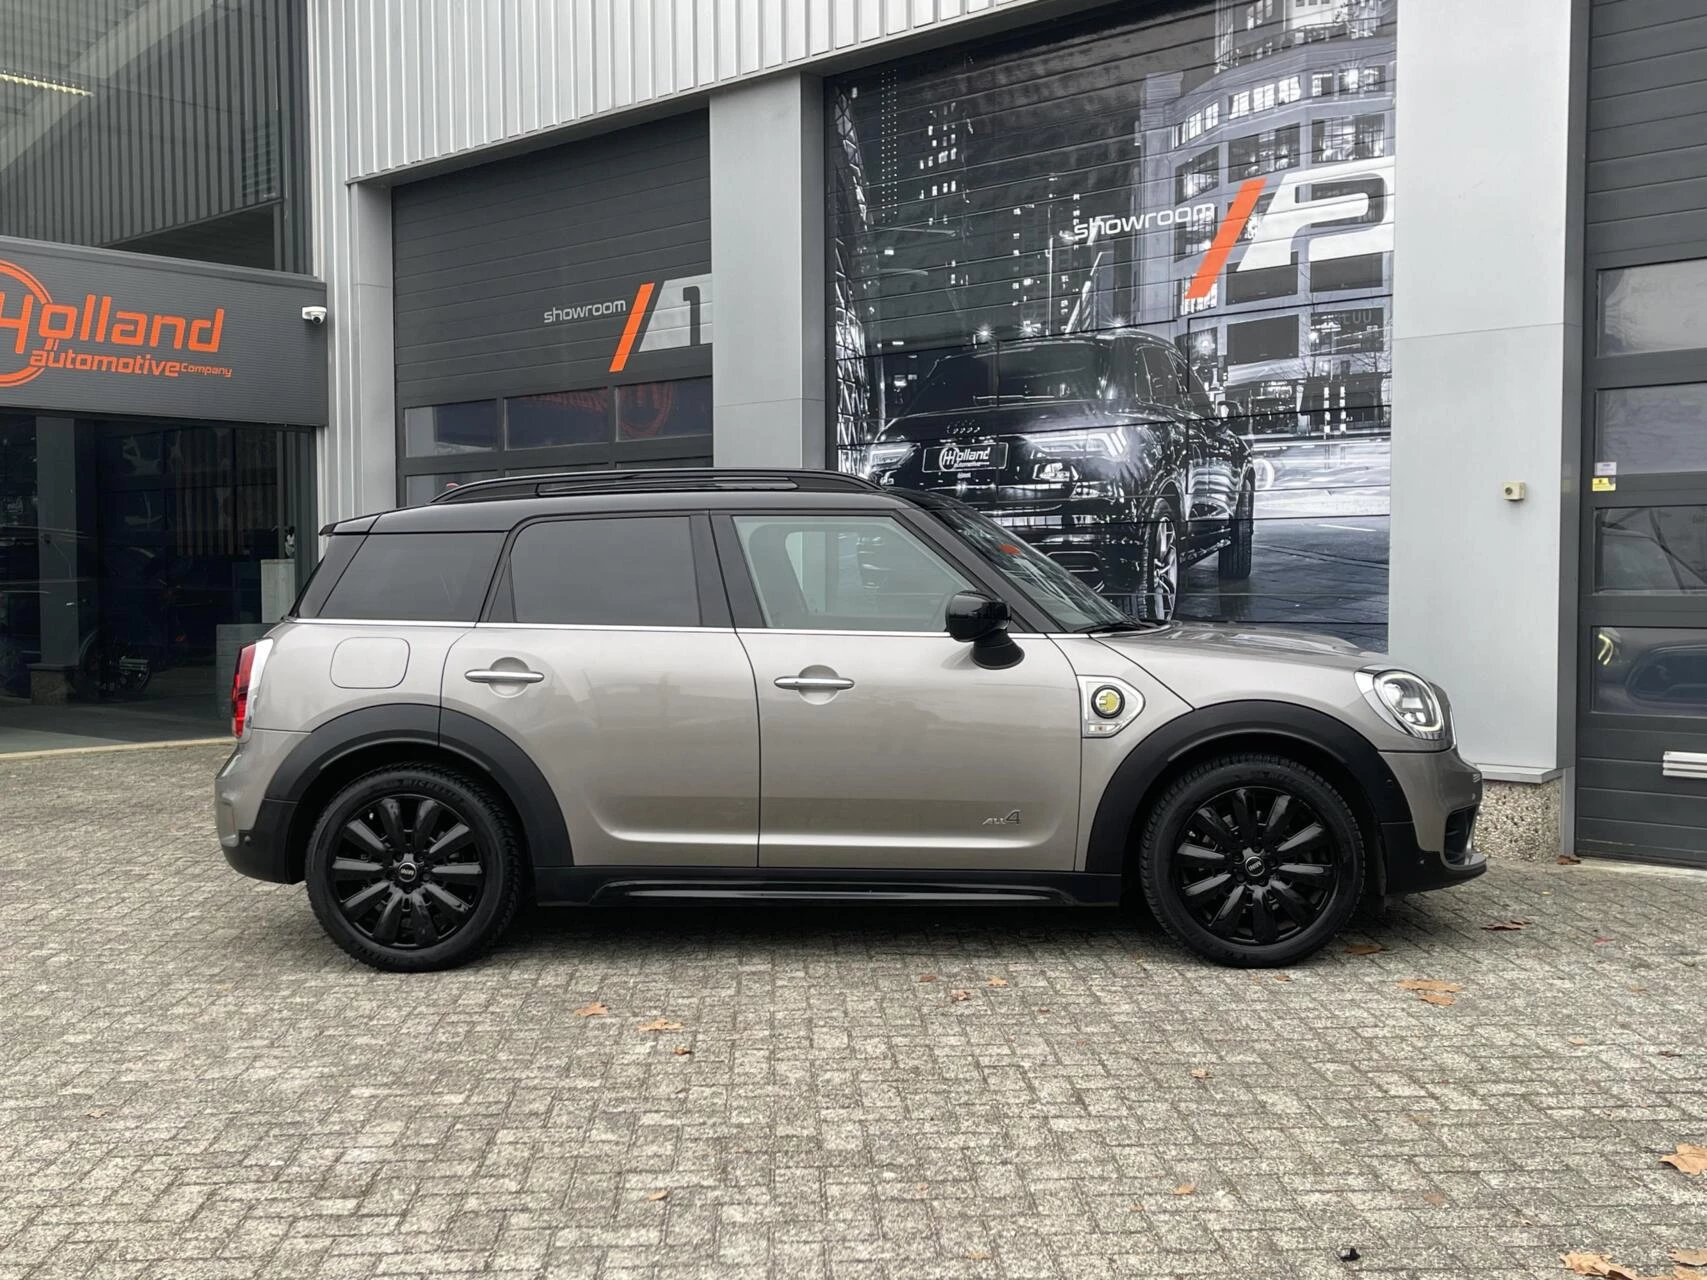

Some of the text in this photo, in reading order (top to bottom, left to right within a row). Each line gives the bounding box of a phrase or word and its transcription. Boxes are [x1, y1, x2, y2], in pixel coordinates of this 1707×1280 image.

[1073, 203, 1215, 239] showroom
[543, 300, 626, 323] showroom
[29, 348, 233, 378] automotive Company
